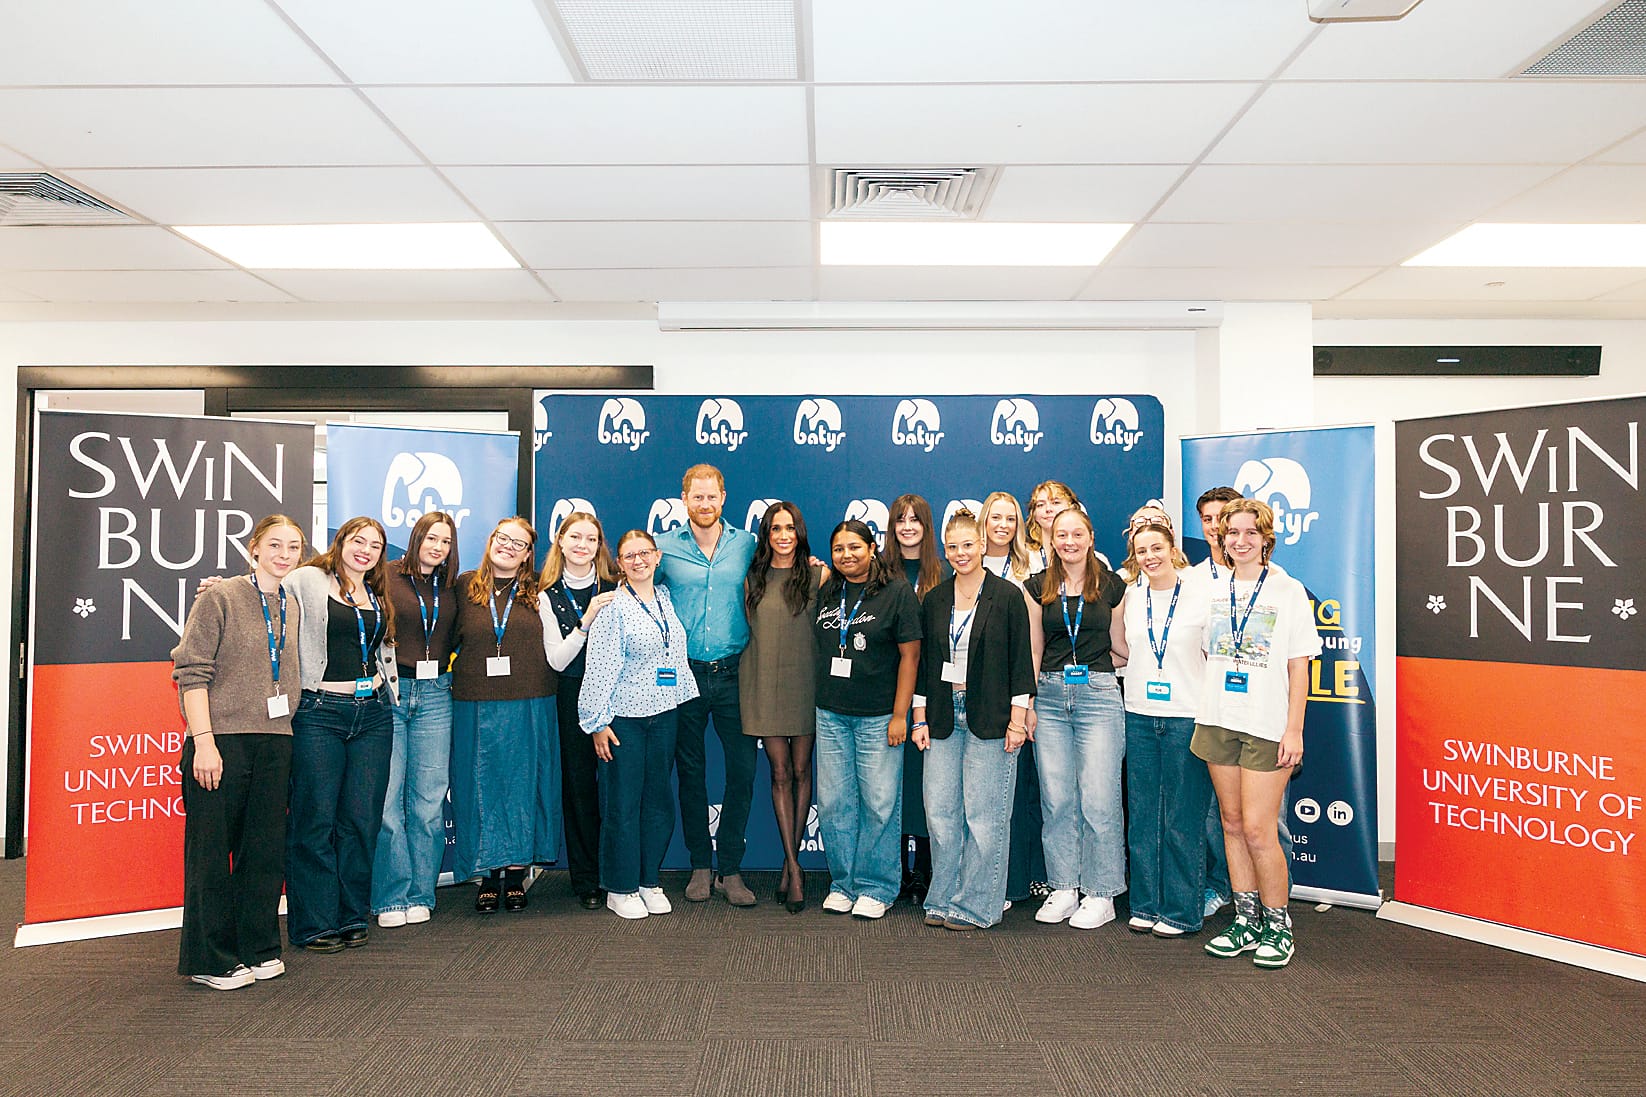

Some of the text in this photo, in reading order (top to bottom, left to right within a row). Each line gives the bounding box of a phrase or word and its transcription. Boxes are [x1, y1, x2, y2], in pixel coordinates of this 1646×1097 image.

[597, 423, 650, 452] batyr
[695, 424, 748, 452] batyr
[793, 424, 846, 452] batyr
[891, 424, 945, 452] batyr
[990, 424, 1044, 452] batyr
[1089, 423, 1144, 452] batyr
[98, 506, 255, 570] BUR
[1445, 500, 1619, 568] BUR
[121, 577, 212, 640] N
[1468, 575, 1593, 644] NE
[89, 731, 187, 758] SWINB
[1443, 739, 1616, 781] SWINBURNE
[1422, 768, 1642, 820] UNIVERSITY OF
[1428, 801, 1636, 856] TECHNOLOGY
